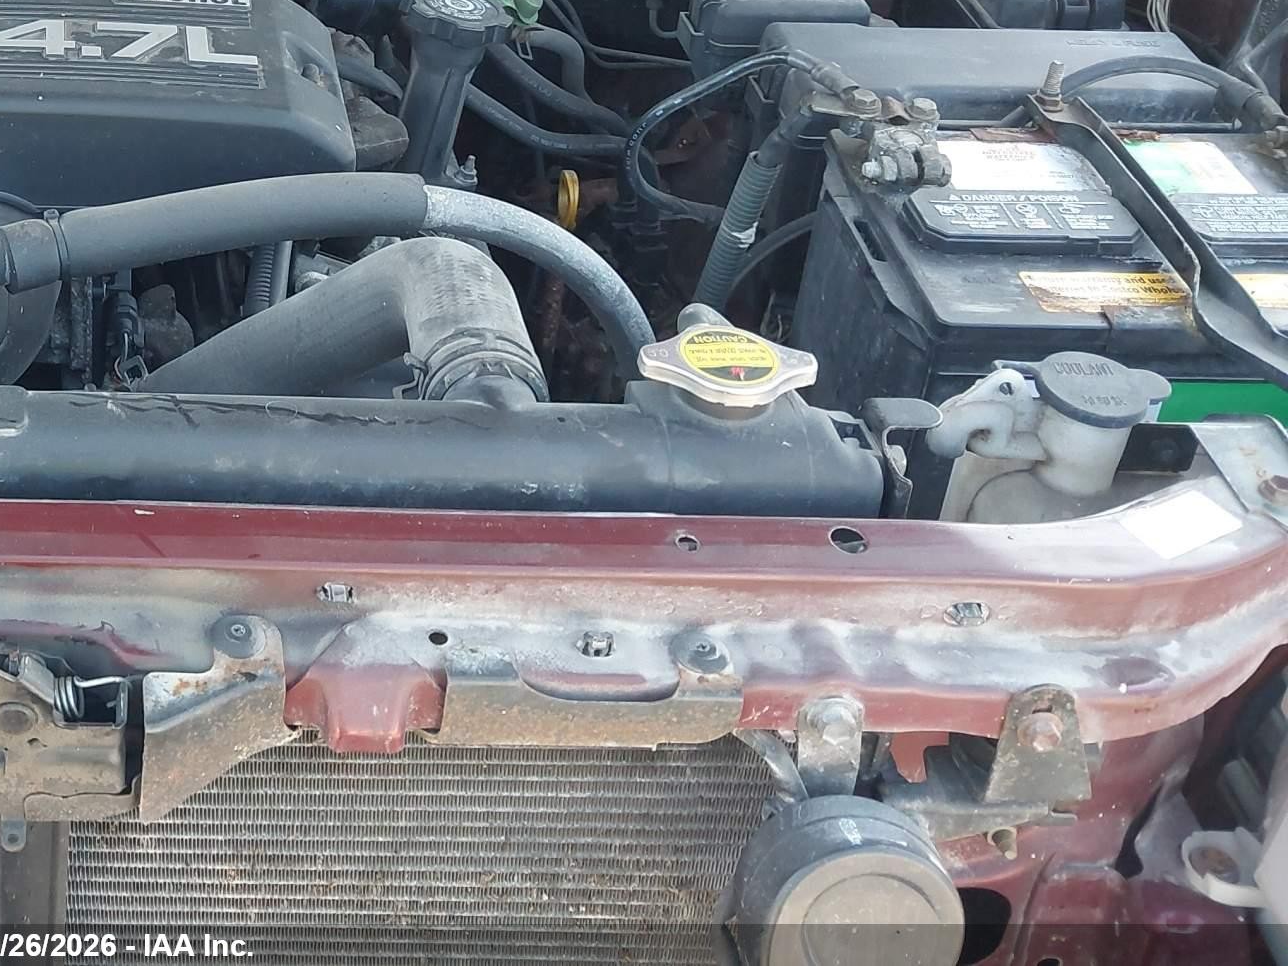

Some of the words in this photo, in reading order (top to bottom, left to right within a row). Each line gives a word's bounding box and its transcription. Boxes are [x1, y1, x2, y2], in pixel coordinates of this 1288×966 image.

[962, 194, 1017, 202] DANGER
[1028, 194, 1080, 203] POISON
[1124, 276, 1146, 284] and
[693, 335, 748, 344] CAUTION
